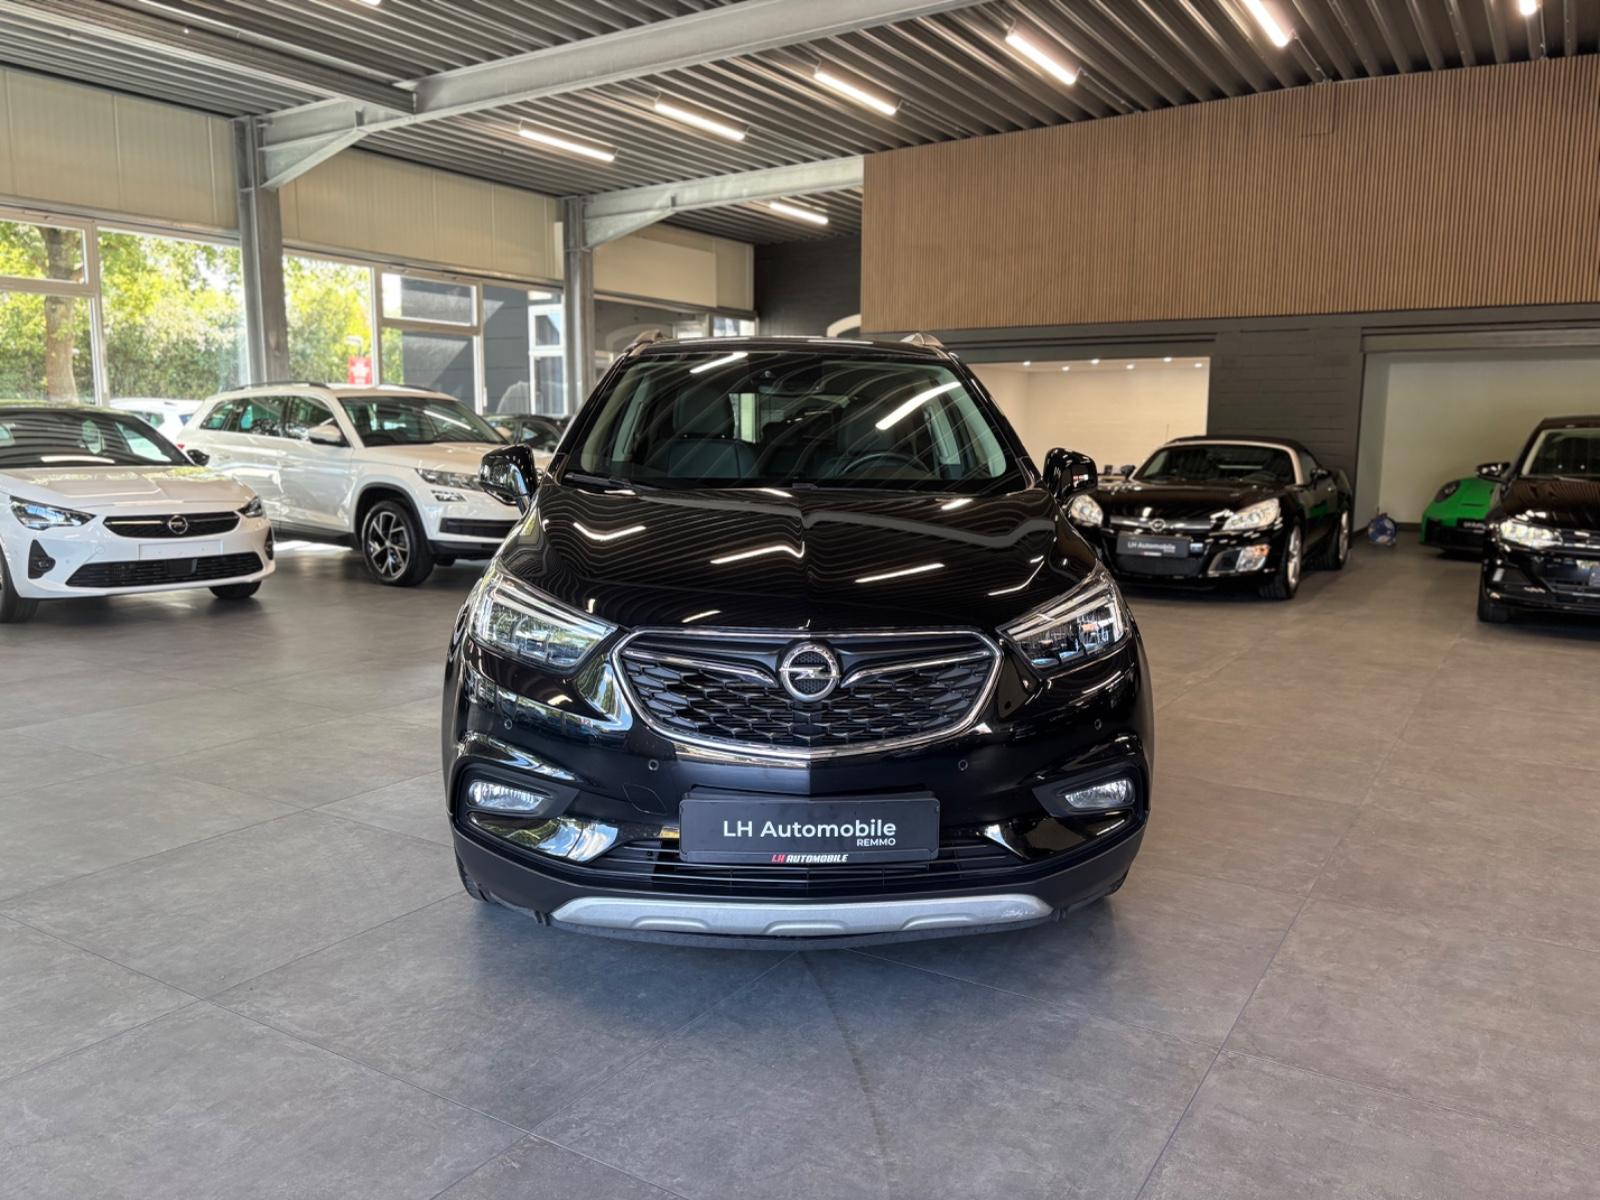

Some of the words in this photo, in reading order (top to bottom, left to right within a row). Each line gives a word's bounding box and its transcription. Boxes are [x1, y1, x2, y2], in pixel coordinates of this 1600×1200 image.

[723, 820, 753, 837] LH
[760, 818, 897, 837] Automobile
[856, 837, 897, 847] REMMO
[771, 854, 785, 863] LH
[785, 854, 849, 863] AUTOMOBILE
